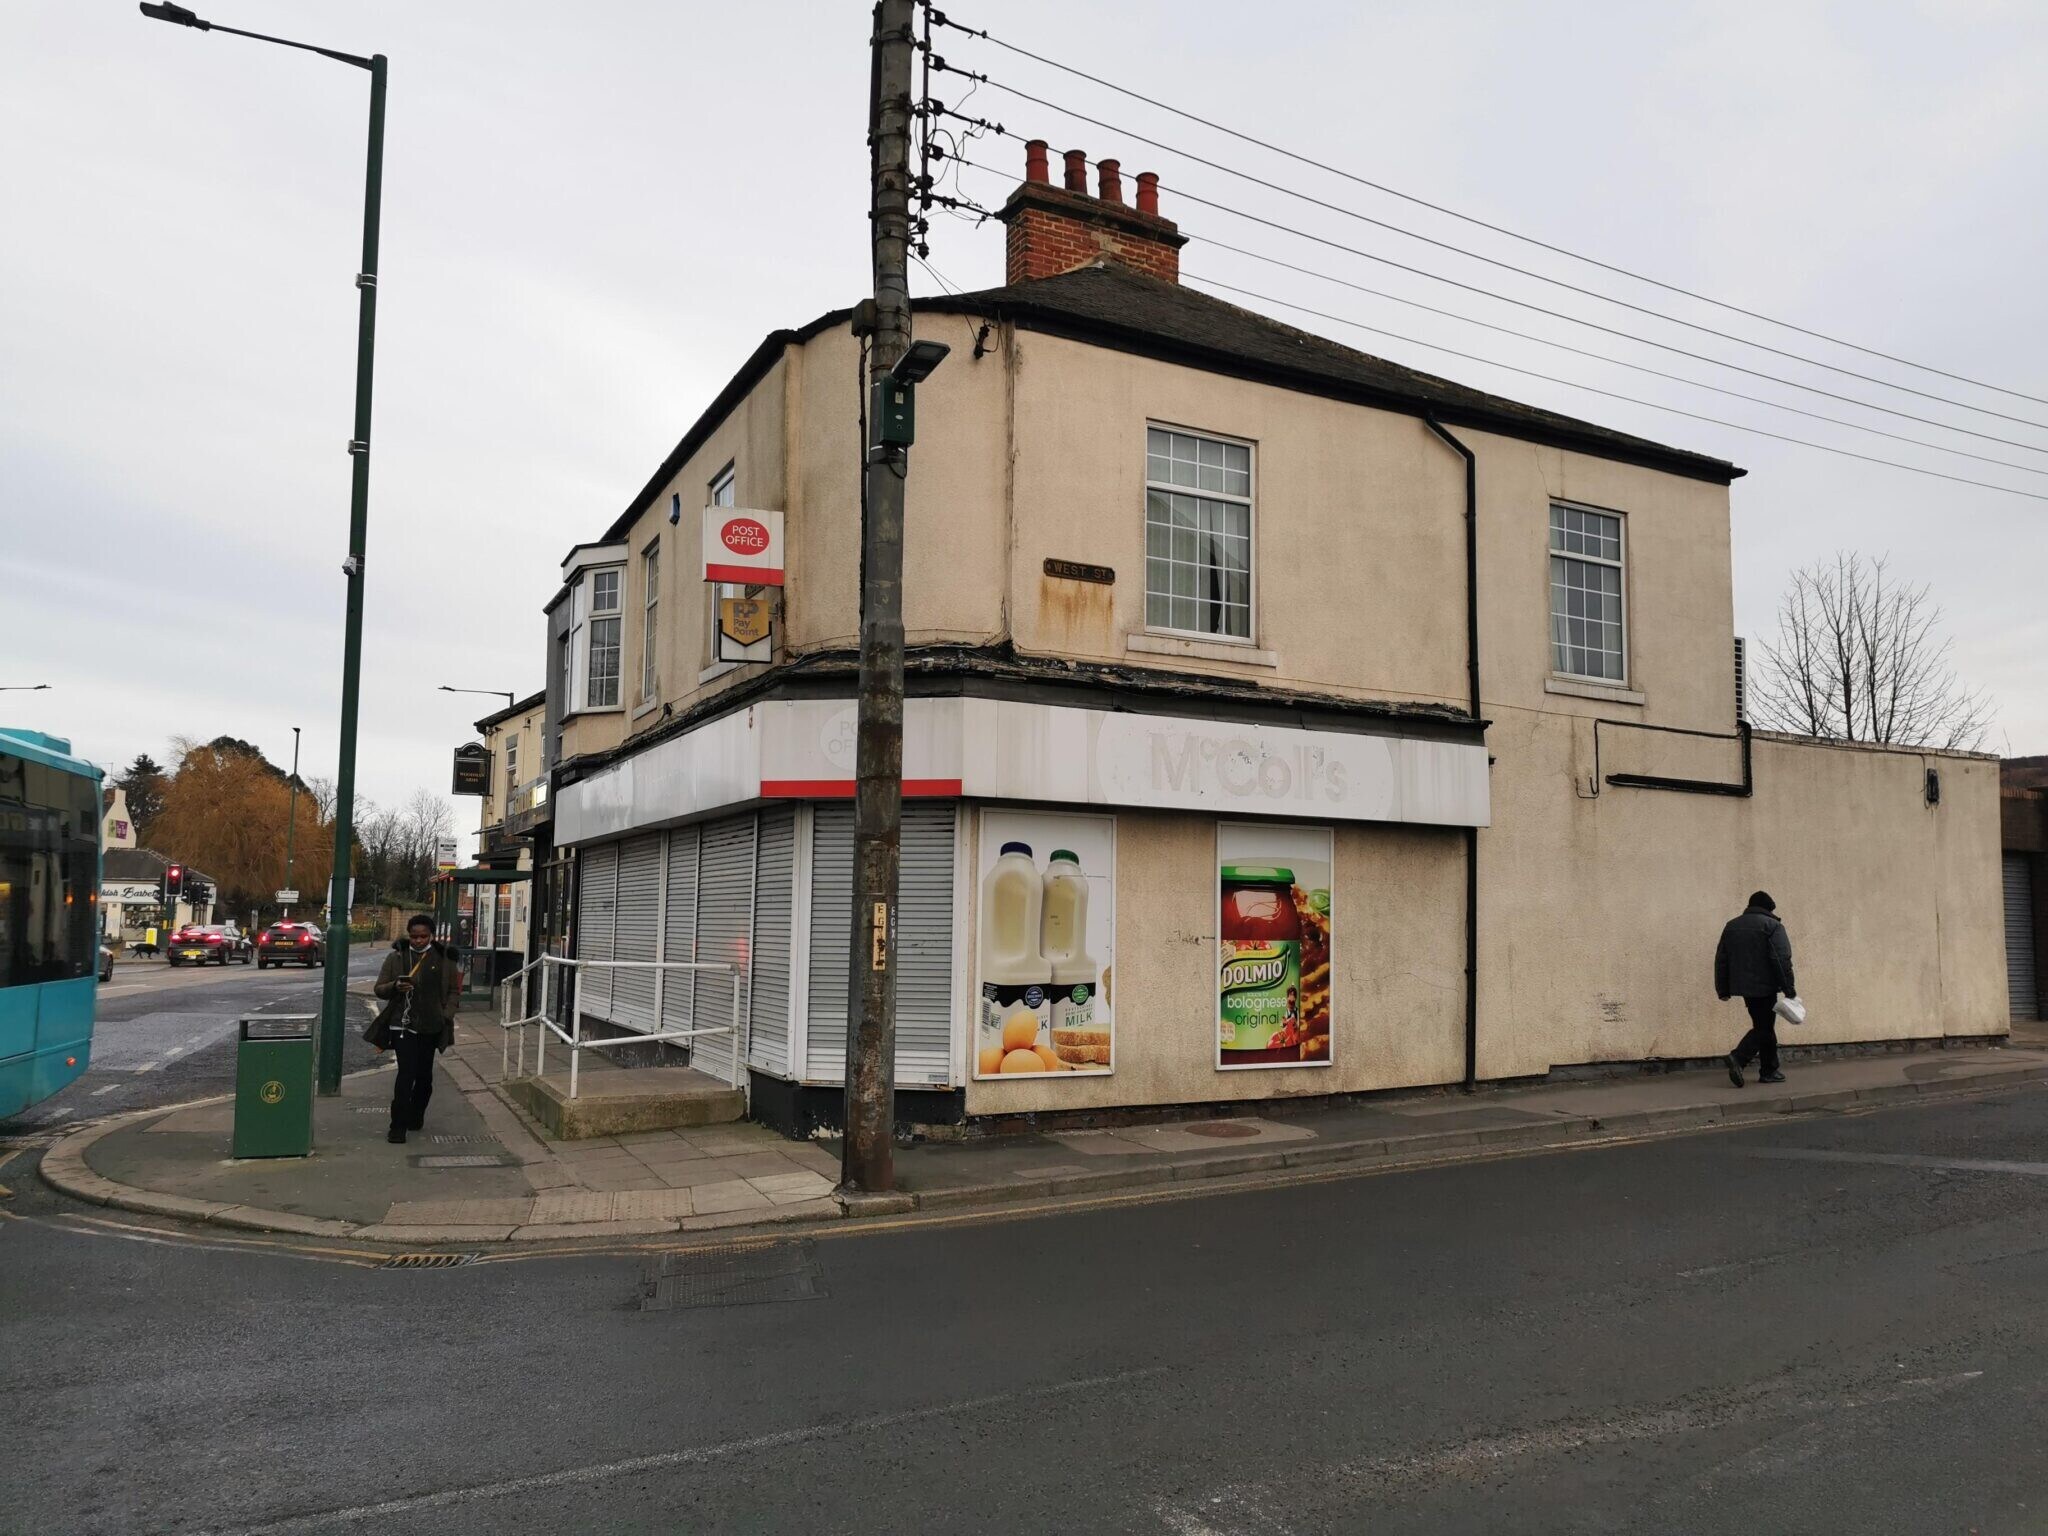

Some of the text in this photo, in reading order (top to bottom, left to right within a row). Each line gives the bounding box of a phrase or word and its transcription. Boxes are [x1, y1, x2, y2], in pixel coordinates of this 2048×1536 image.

[732, 525, 760, 536] POST
[725, 535, 764, 547] OFFICE
[1053, 561, 1087, 577] WEST
[733, 618, 751, 629] Pay
[733, 626, 759, 637] Point
[1223, 961, 1282, 988] DOLMIO
[1227, 995, 1287, 1012] bolognese
[1065, 1012, 1092, 1027] MILK
[1235, 1012, 1279, 1028] original
